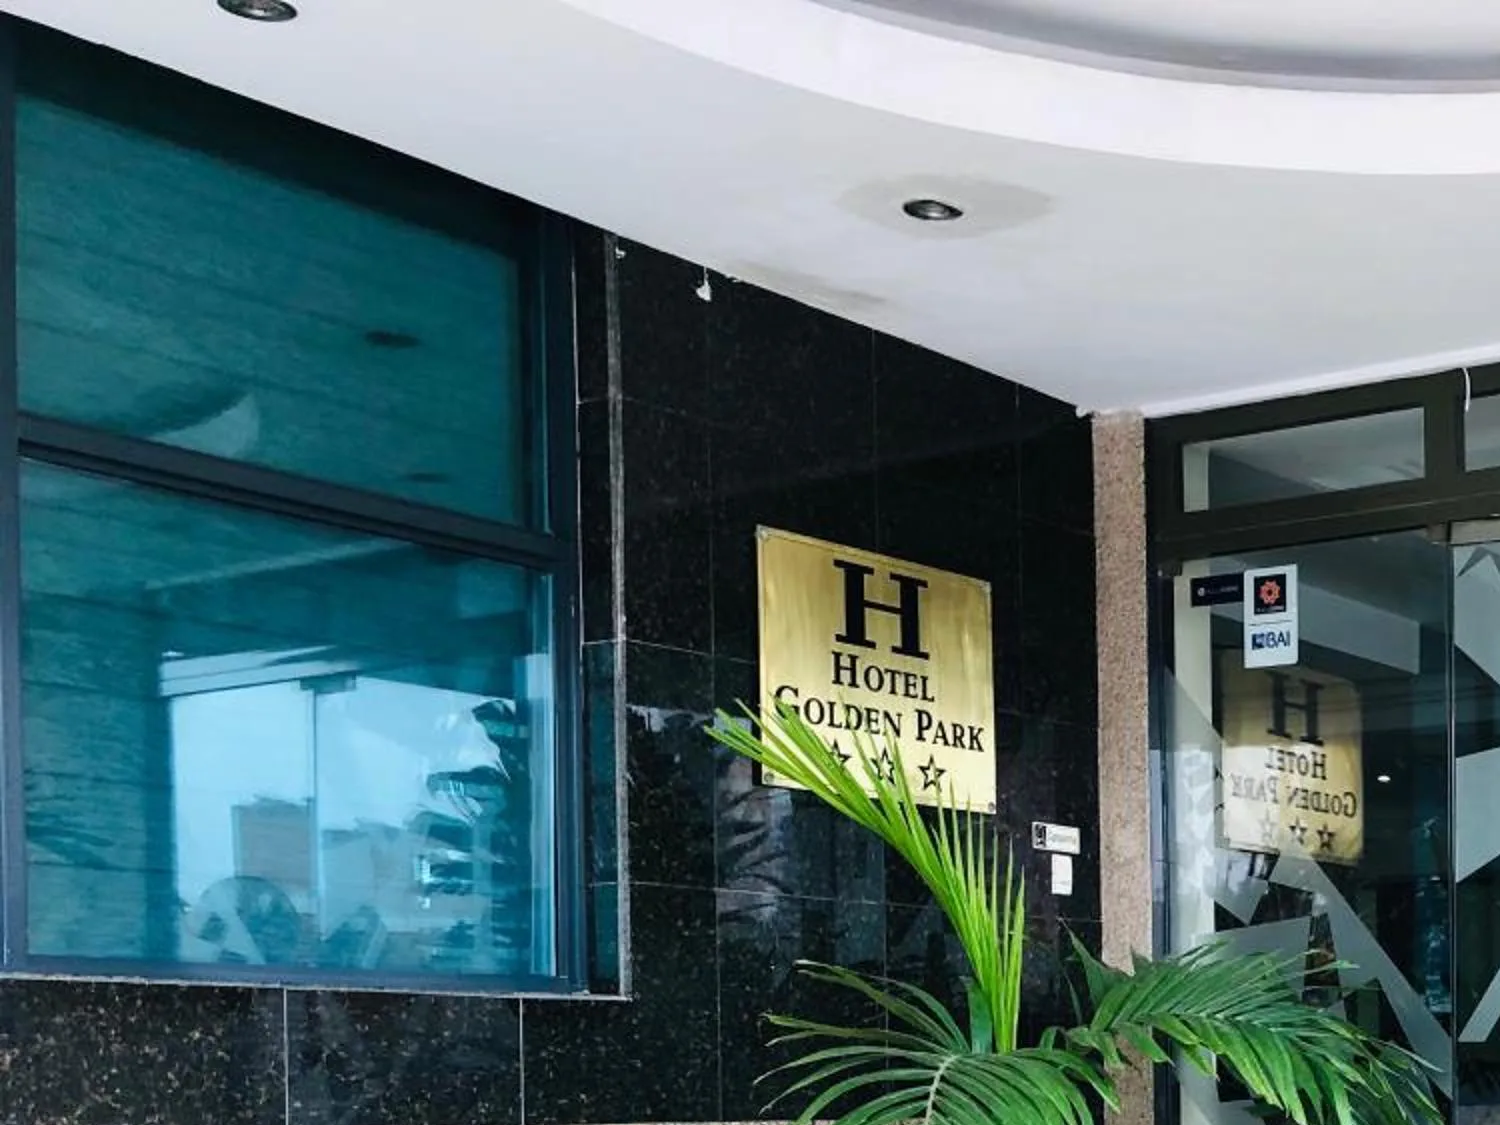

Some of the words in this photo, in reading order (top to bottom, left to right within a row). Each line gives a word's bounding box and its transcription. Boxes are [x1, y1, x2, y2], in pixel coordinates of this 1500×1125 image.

[833, 558, 929, 660] H
[1266, 630, 1290, 648] BAI
[831, 651, 935, 702] HOTEL
[774, 684, 902, 738] GOLDEN
[915, 709, 985, 752] PARK
